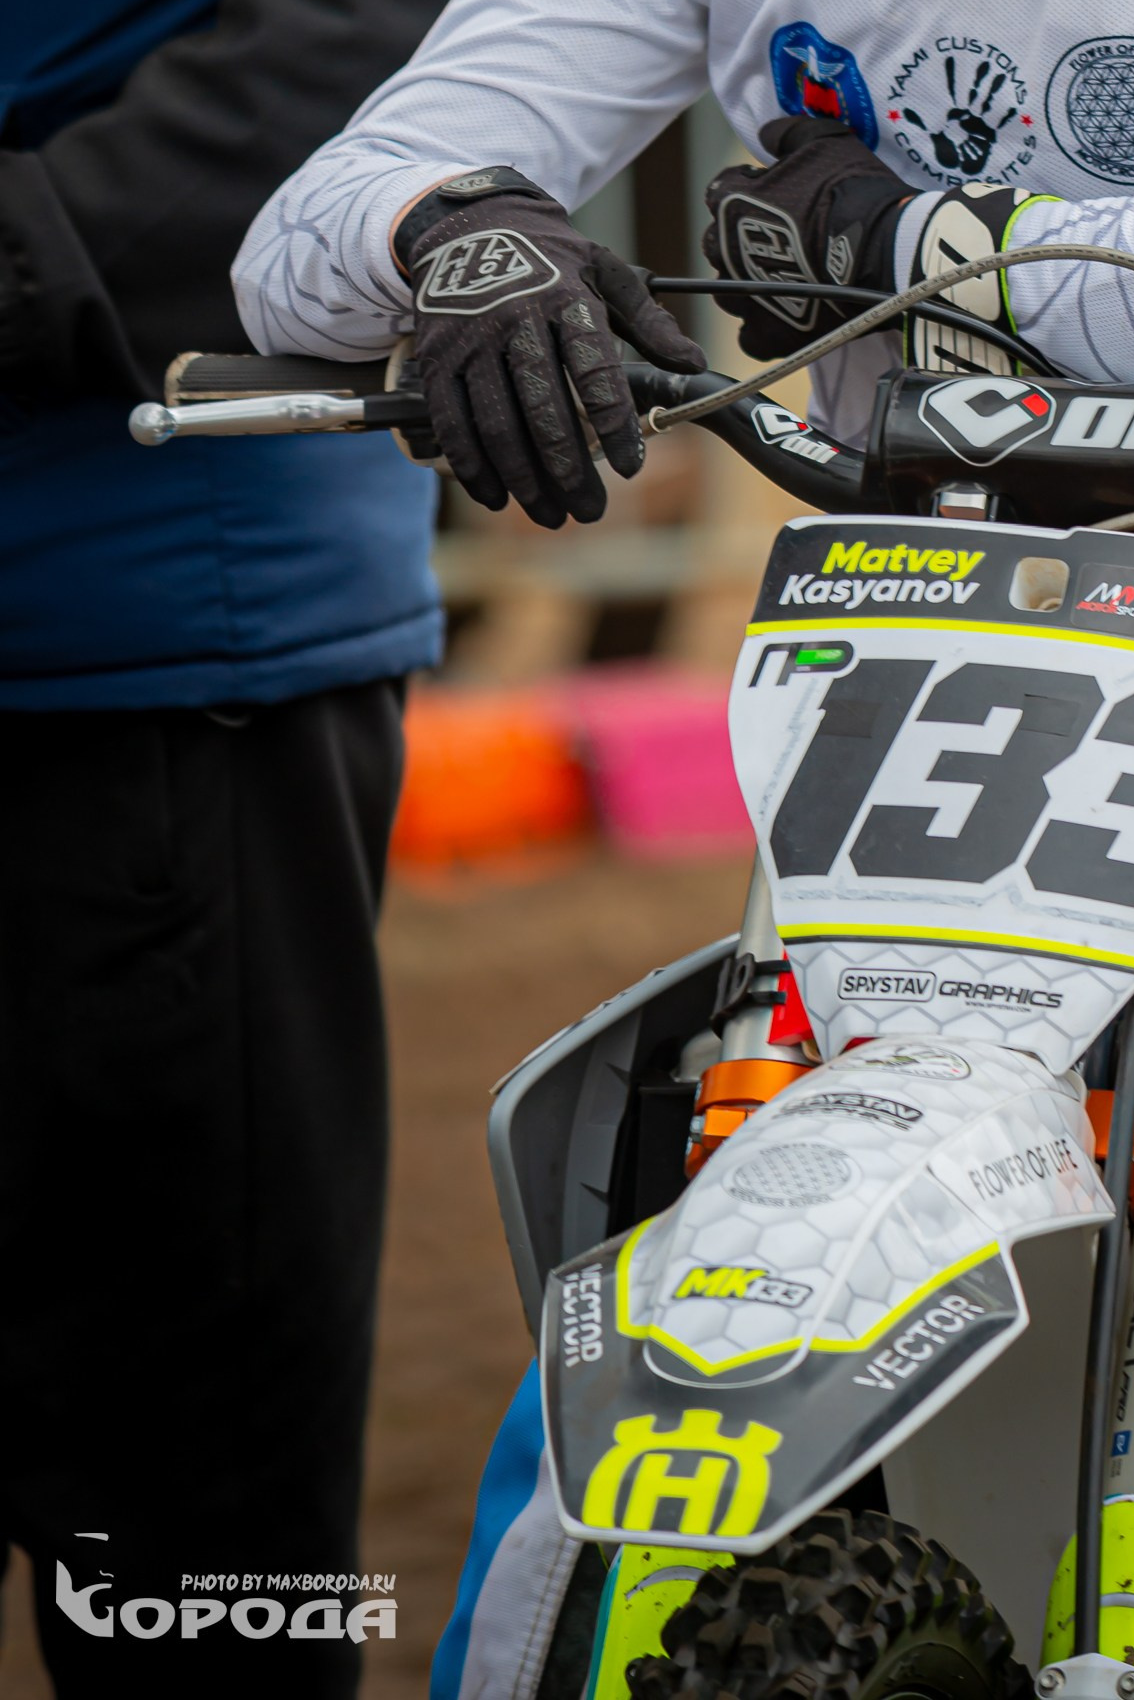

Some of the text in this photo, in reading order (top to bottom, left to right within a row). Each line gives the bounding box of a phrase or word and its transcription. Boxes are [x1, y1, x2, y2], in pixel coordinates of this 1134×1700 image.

[1115, 44, 1134, 55] OF
[887, 48, 930, 101] YAMI
[935, 36, 1028, 105] CUSTOMS
[822, 541, 986, 581] Matvey
[778, 573, 981, 609] Kasyanov
[842, 974, 1064, 1009] SPYSTAV GRAPHICS
[968, 1138, 1079, 1201] FLOWER OF LIFE
[674, 1266, 813, 1307] MK133
[852, 1293, 985, 1391] VECTOR
